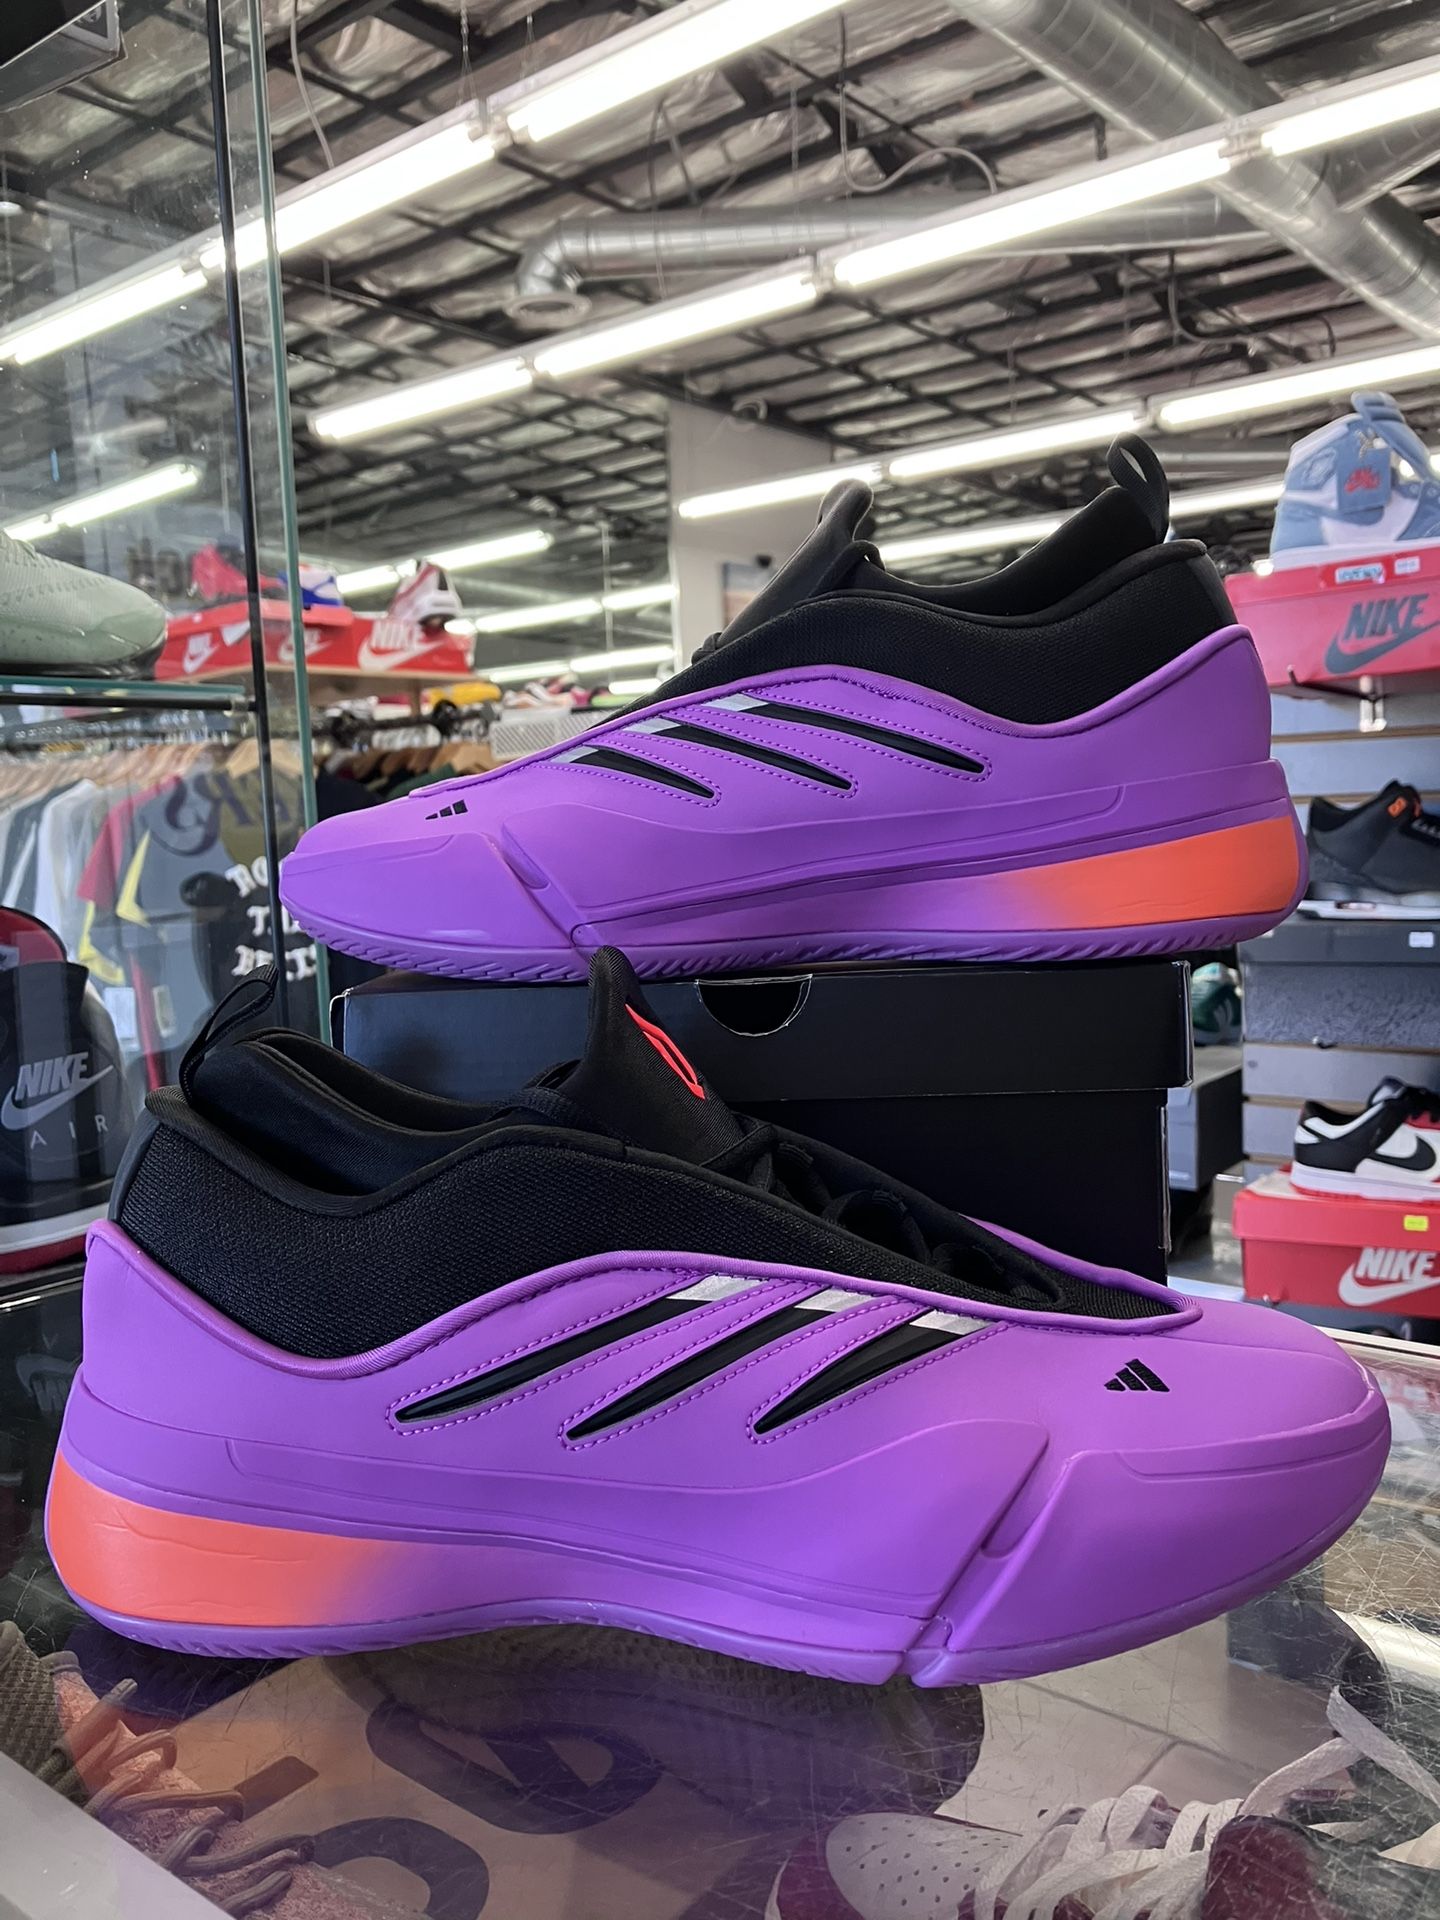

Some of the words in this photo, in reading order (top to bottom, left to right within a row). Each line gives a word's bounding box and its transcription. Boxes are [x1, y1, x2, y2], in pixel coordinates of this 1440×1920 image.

[1342, 593, 1429, 641] NIKE
[15, 1052, 88, 1101] NIKE
[30, 1114, 108, 1149] AIR
[1355, 1246, 1437, 1281] NIKE
